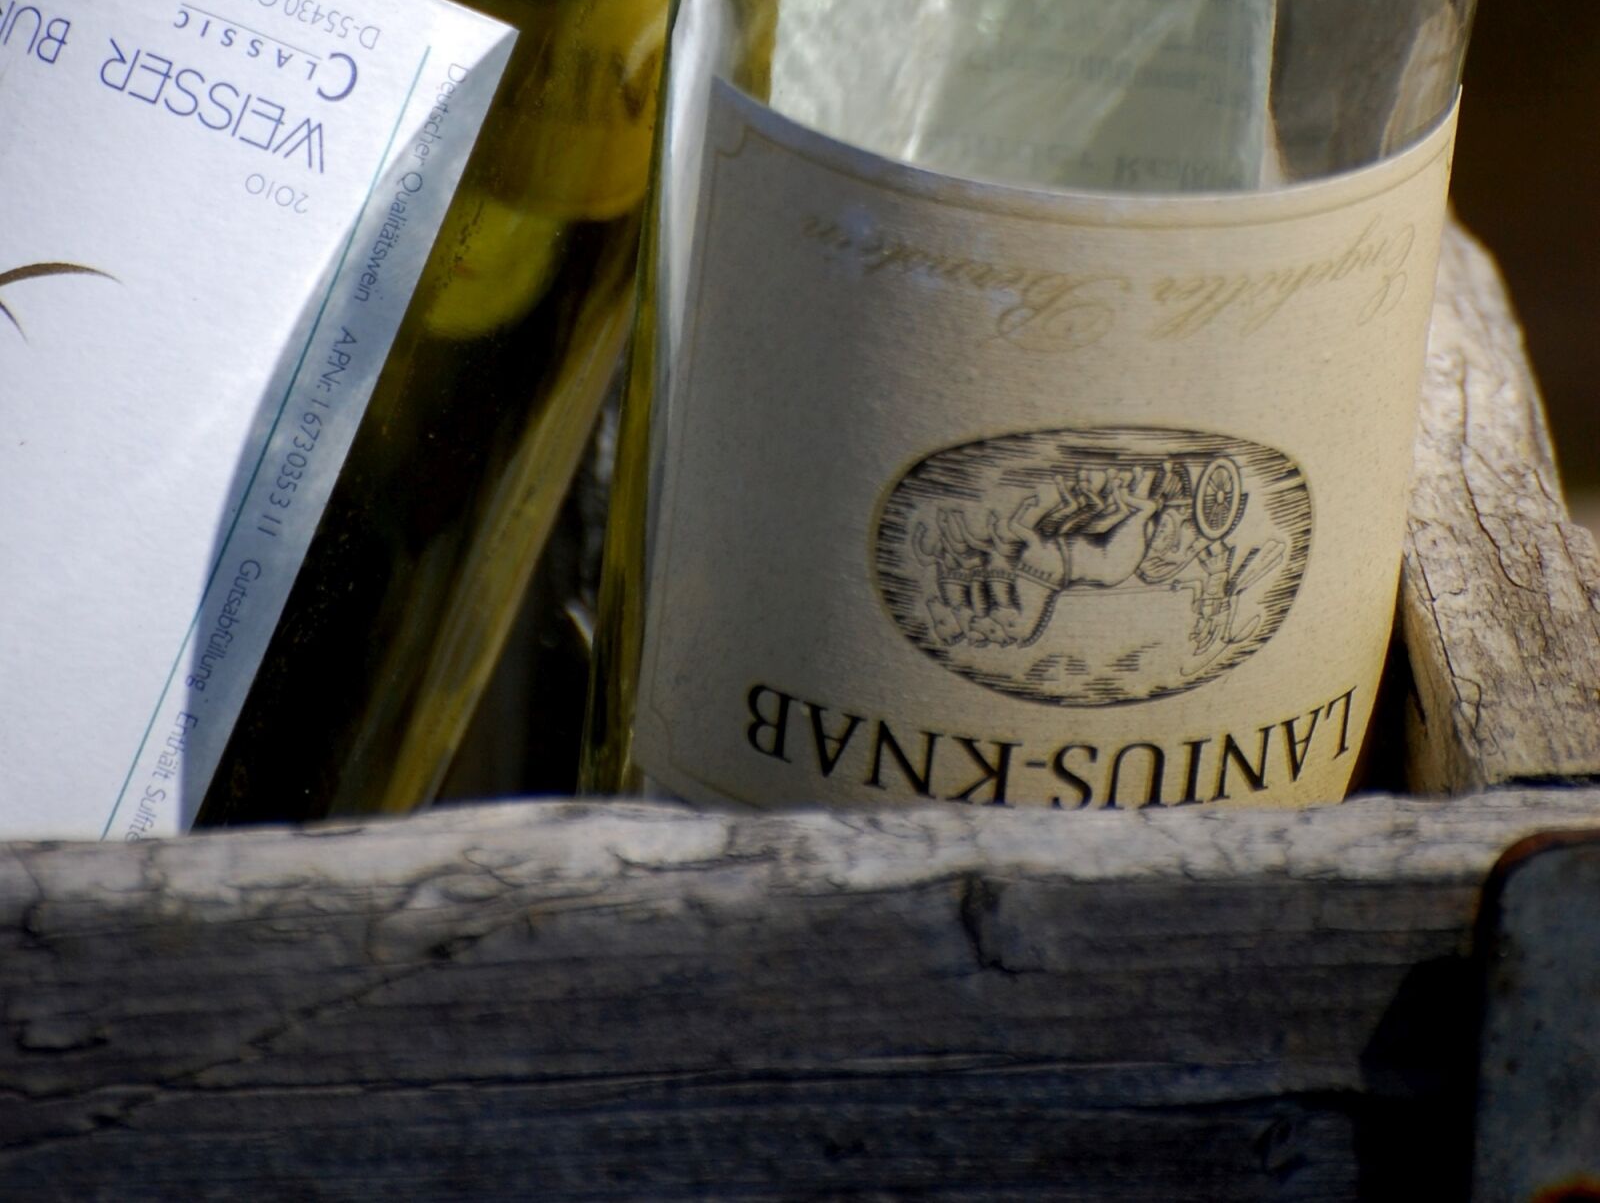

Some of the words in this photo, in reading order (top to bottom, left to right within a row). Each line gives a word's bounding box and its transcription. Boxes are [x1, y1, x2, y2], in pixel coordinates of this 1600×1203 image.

[99, 37, 325, 174] WEISSER
[414, 62, 469, 166] Deutscher
[244, 172, 310, 215] 2010
[353, 170, 424, 303] Qualitätswein
[184, 558, 262, 692] Gutsabfüllung
[151, 710, 199, 781] Enthält
[745, 683, 1358, 811] LANIUS-KNAB
